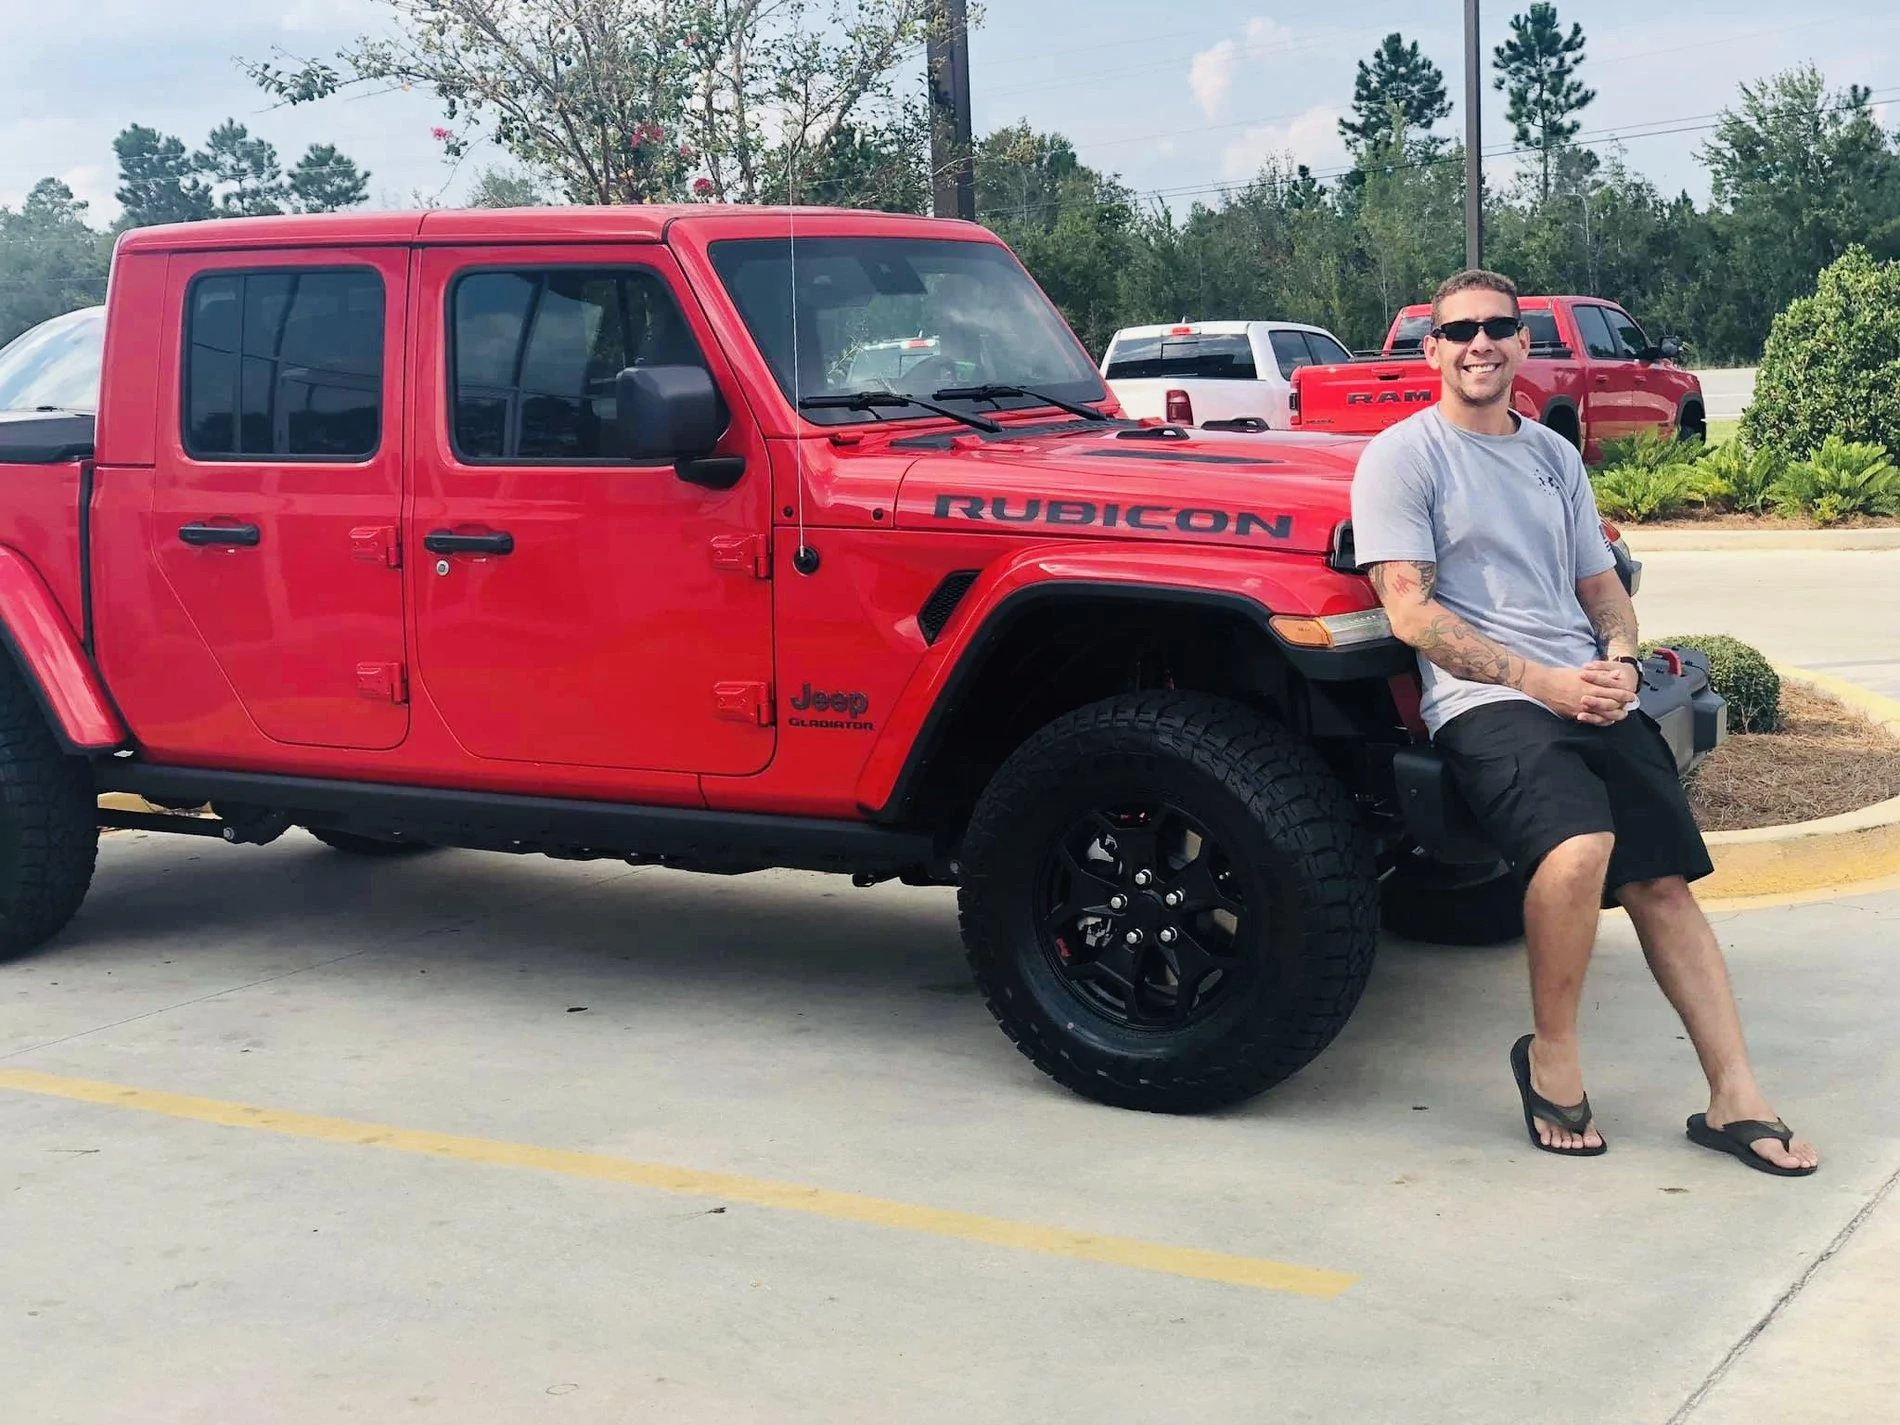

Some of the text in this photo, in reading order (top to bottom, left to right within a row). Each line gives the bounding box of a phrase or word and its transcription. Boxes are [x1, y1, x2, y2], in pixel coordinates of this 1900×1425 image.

[1347, 390, 1432, 405] RAM
[934, 494, 1293, 539] RUBICON
[790, 682, 869, 720] Jeep
[788, 717, 875, 731] GLADIATOR
